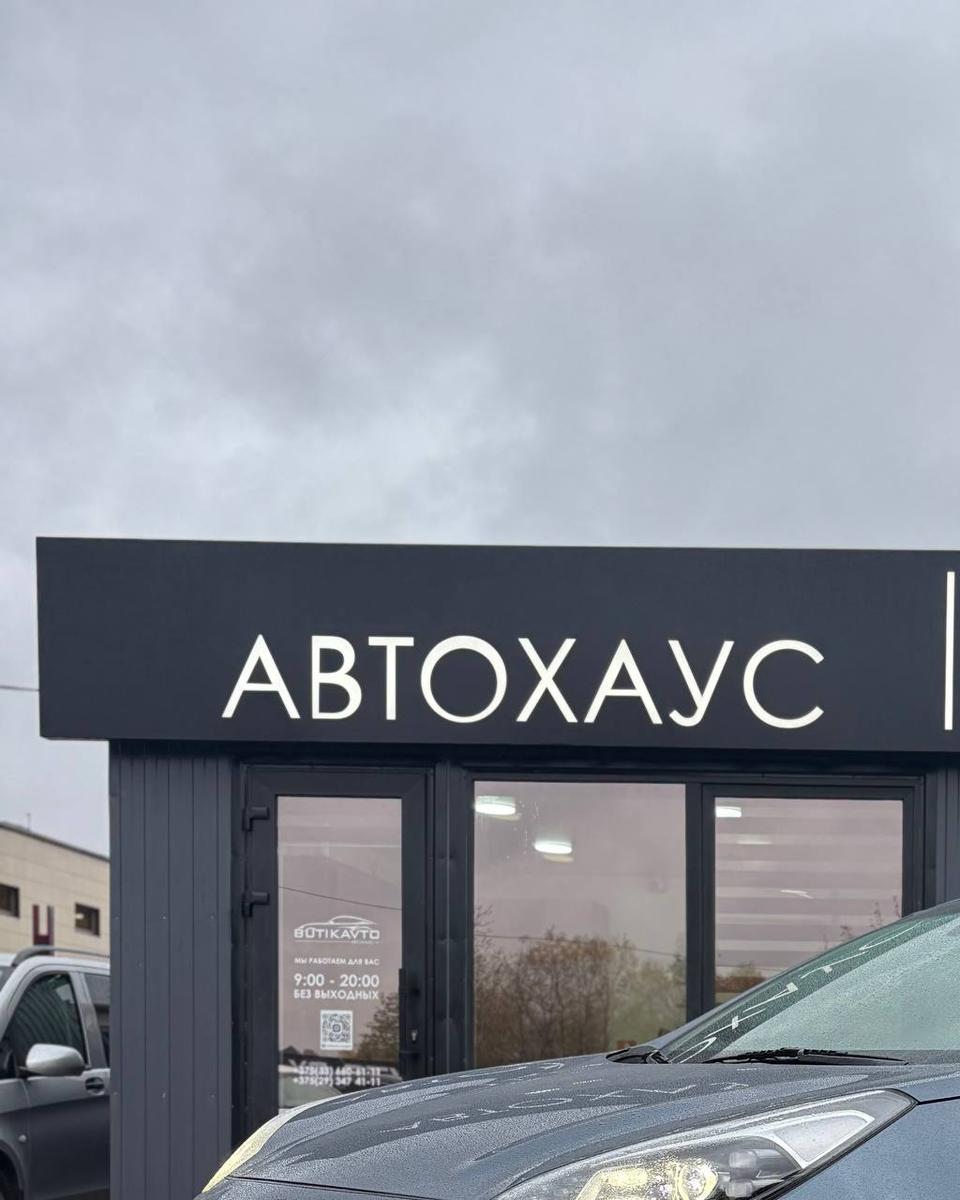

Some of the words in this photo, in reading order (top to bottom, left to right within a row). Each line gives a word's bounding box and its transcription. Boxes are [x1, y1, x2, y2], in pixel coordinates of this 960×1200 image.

[222, 633, 825, 729] АВТОХАУС
[294, 928, 380, 940] BUTIKAVTO
[309, 957, 347, 966] РАБОТАЕМ
[294, 973, 325, 987] 9:00
[340, 973, 380, 988] 20:00
[294, 988, 312, 999] БЕЗ
[314, 989, 379, 1000] ВЫХОДНЫХ
